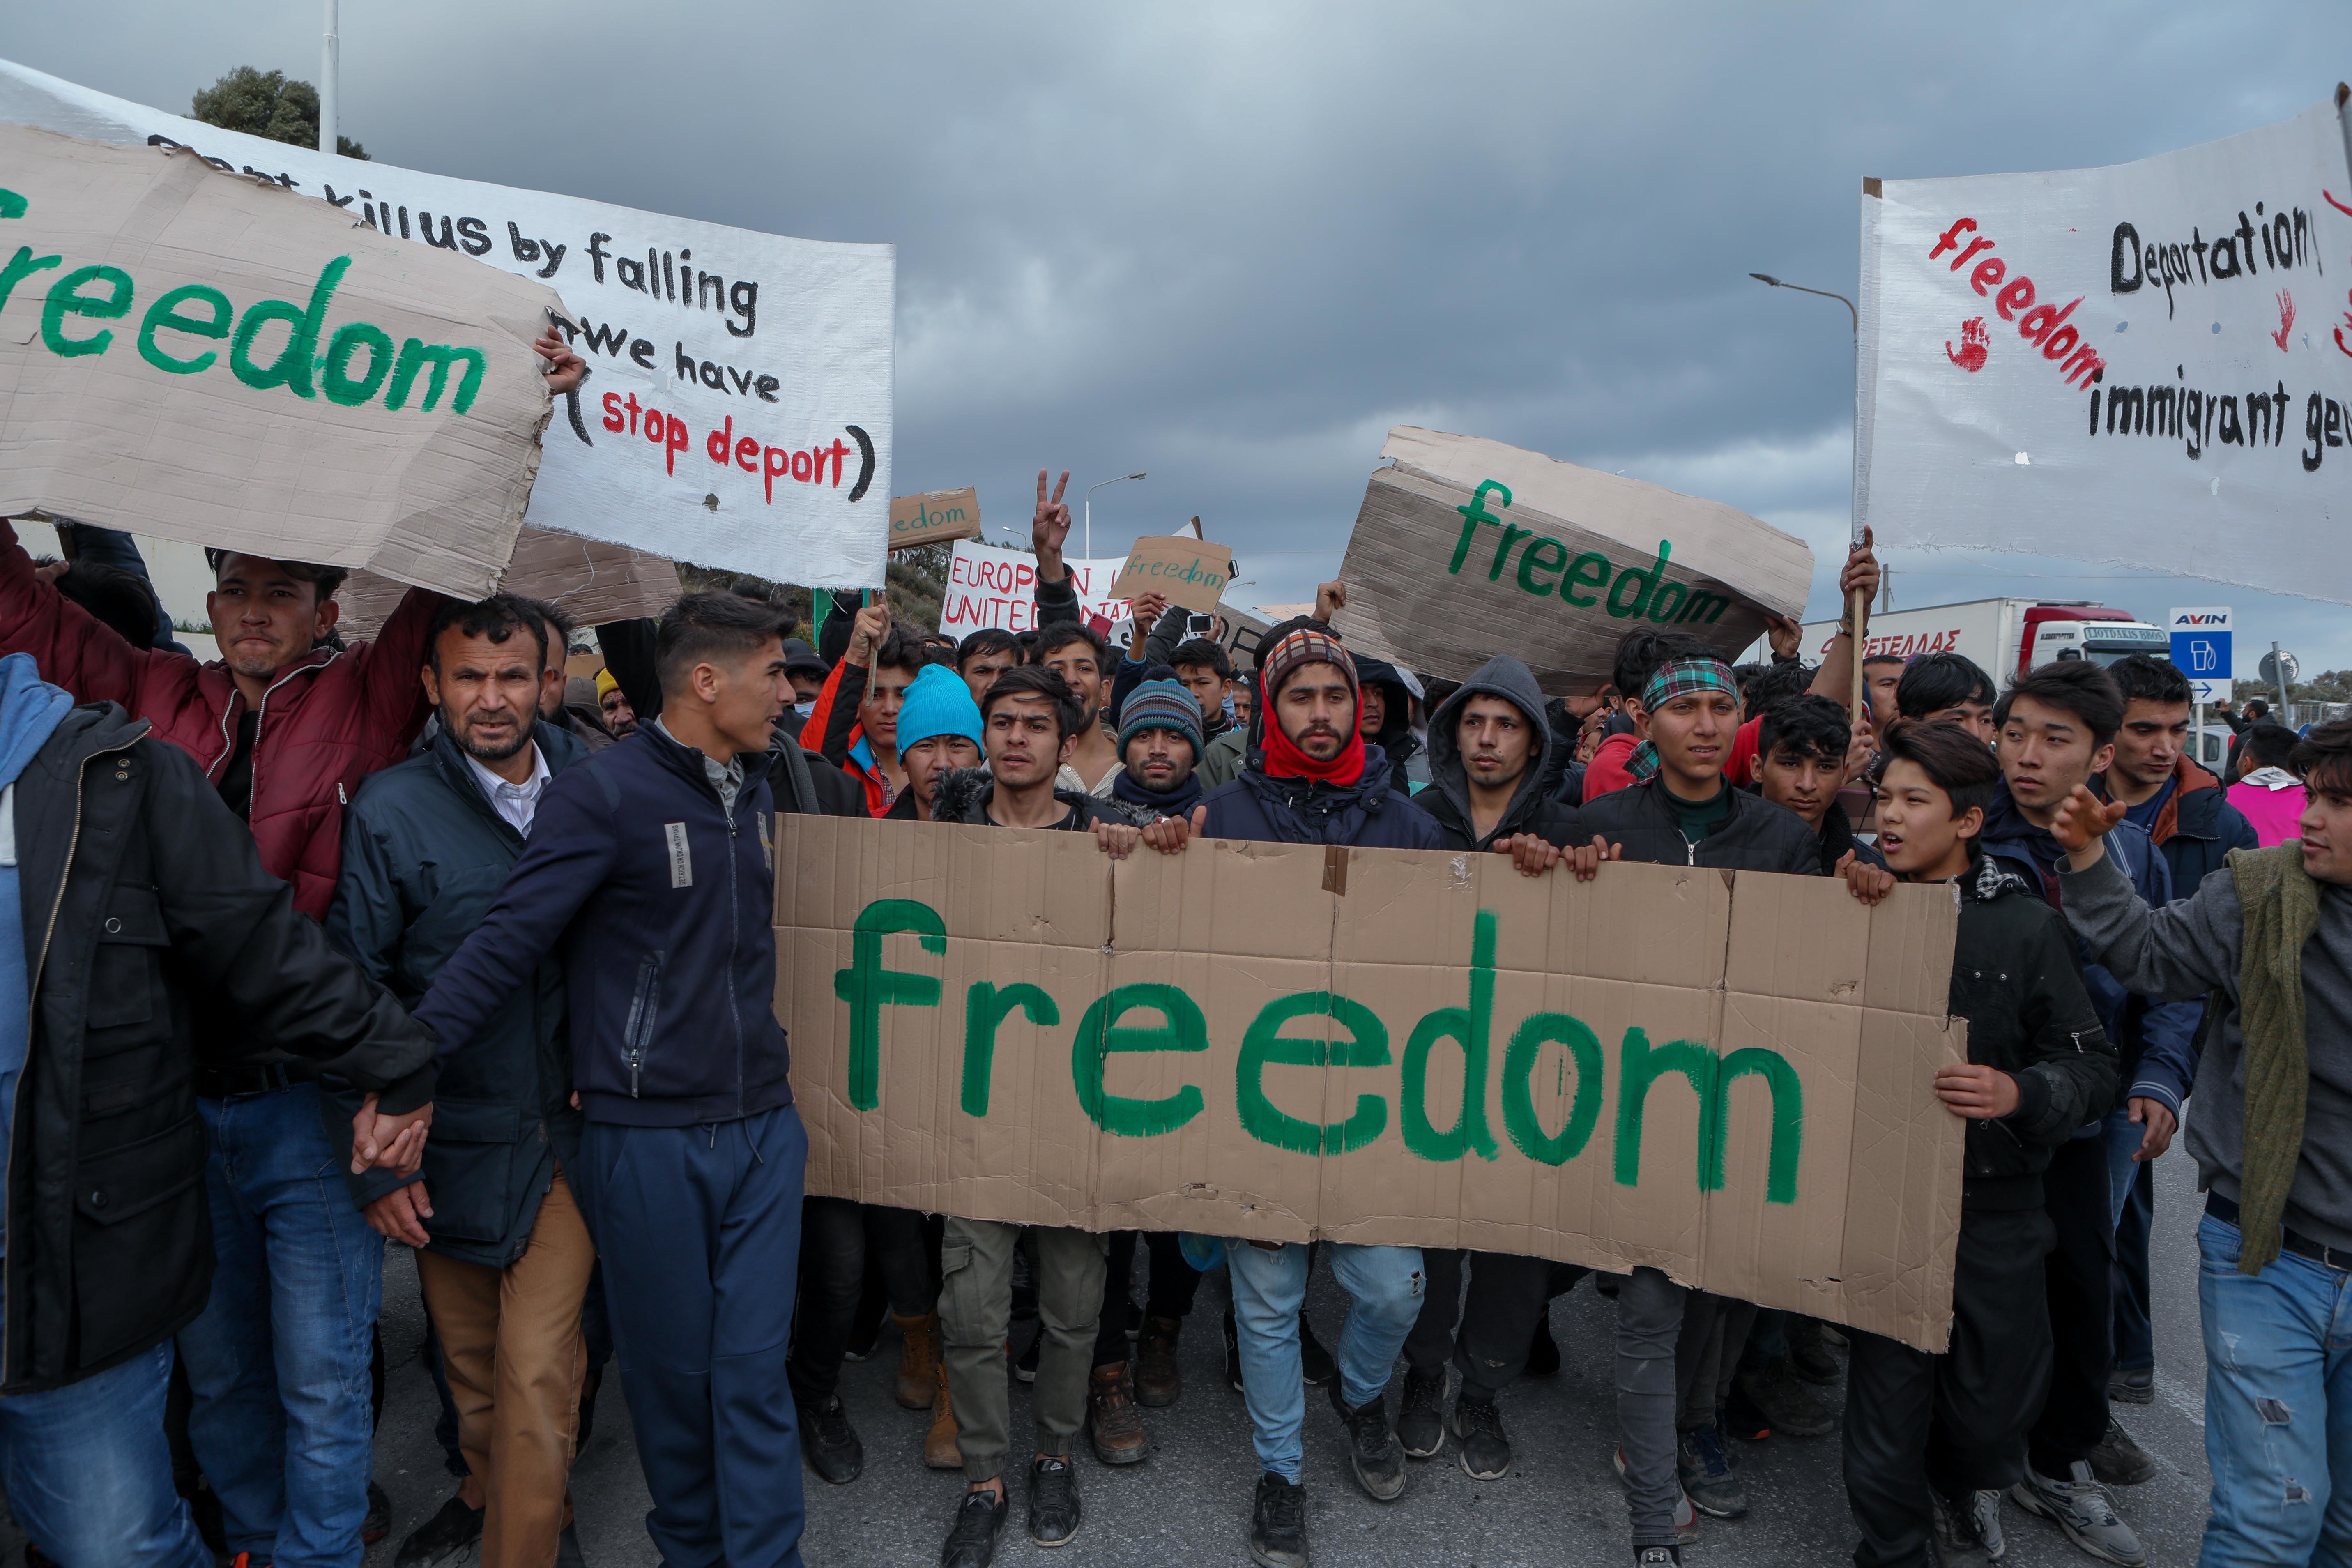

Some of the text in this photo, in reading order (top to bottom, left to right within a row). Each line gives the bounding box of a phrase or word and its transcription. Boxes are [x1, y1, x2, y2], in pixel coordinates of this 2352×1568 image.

[0, 188, 488, 415] reedom
[507, 221, 567, 278] by
[585, 232, 759, 338] falling
[1929, 218, 2105, 390] freedom
[675, 341, 780, 402] have
[2090, 364, 2291, 462] immigrant
[707, 415, 876, 504] deport)
[893, 502, 965, 531] edom
[952, 557, 1091, 596] EUROPN
[1127, 554, 1224, 591] freedom
[1448, 478, 1730, 624] freedom
[2139, 630, 2164, 641] BROS
[2175, 614, 2228, 625] AVIN
[672, 825, 681, 841] TRYING
[675, 842, 684, 857] DRUNK
[834, 898, 1803, 1204] freedom
